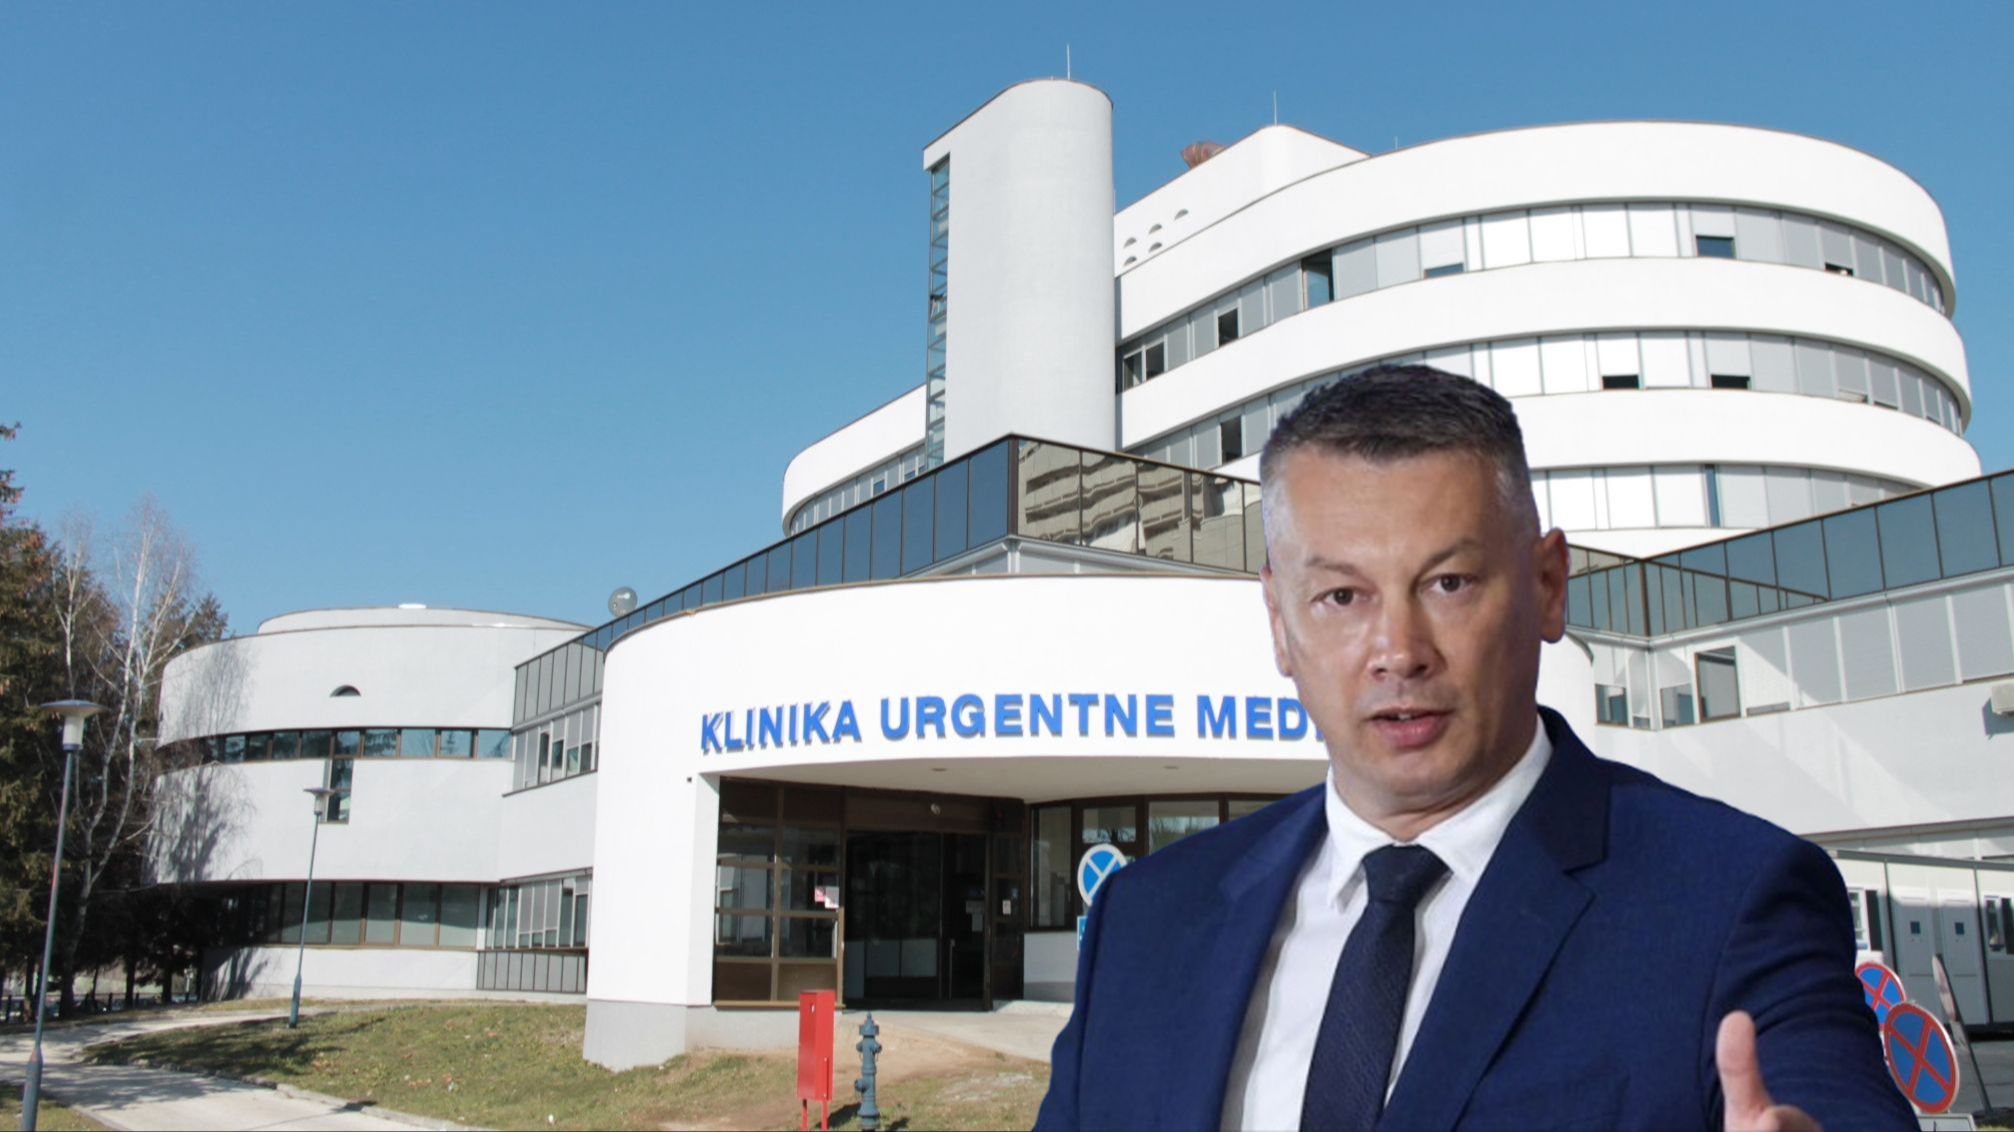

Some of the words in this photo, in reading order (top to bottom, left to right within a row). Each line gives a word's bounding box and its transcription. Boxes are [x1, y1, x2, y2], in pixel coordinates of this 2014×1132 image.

[701, 699, 862, 755] KLINIKA
[880, 693, 1175, 741] URGENTNE
[1197, 695, 1324, 742] MED
